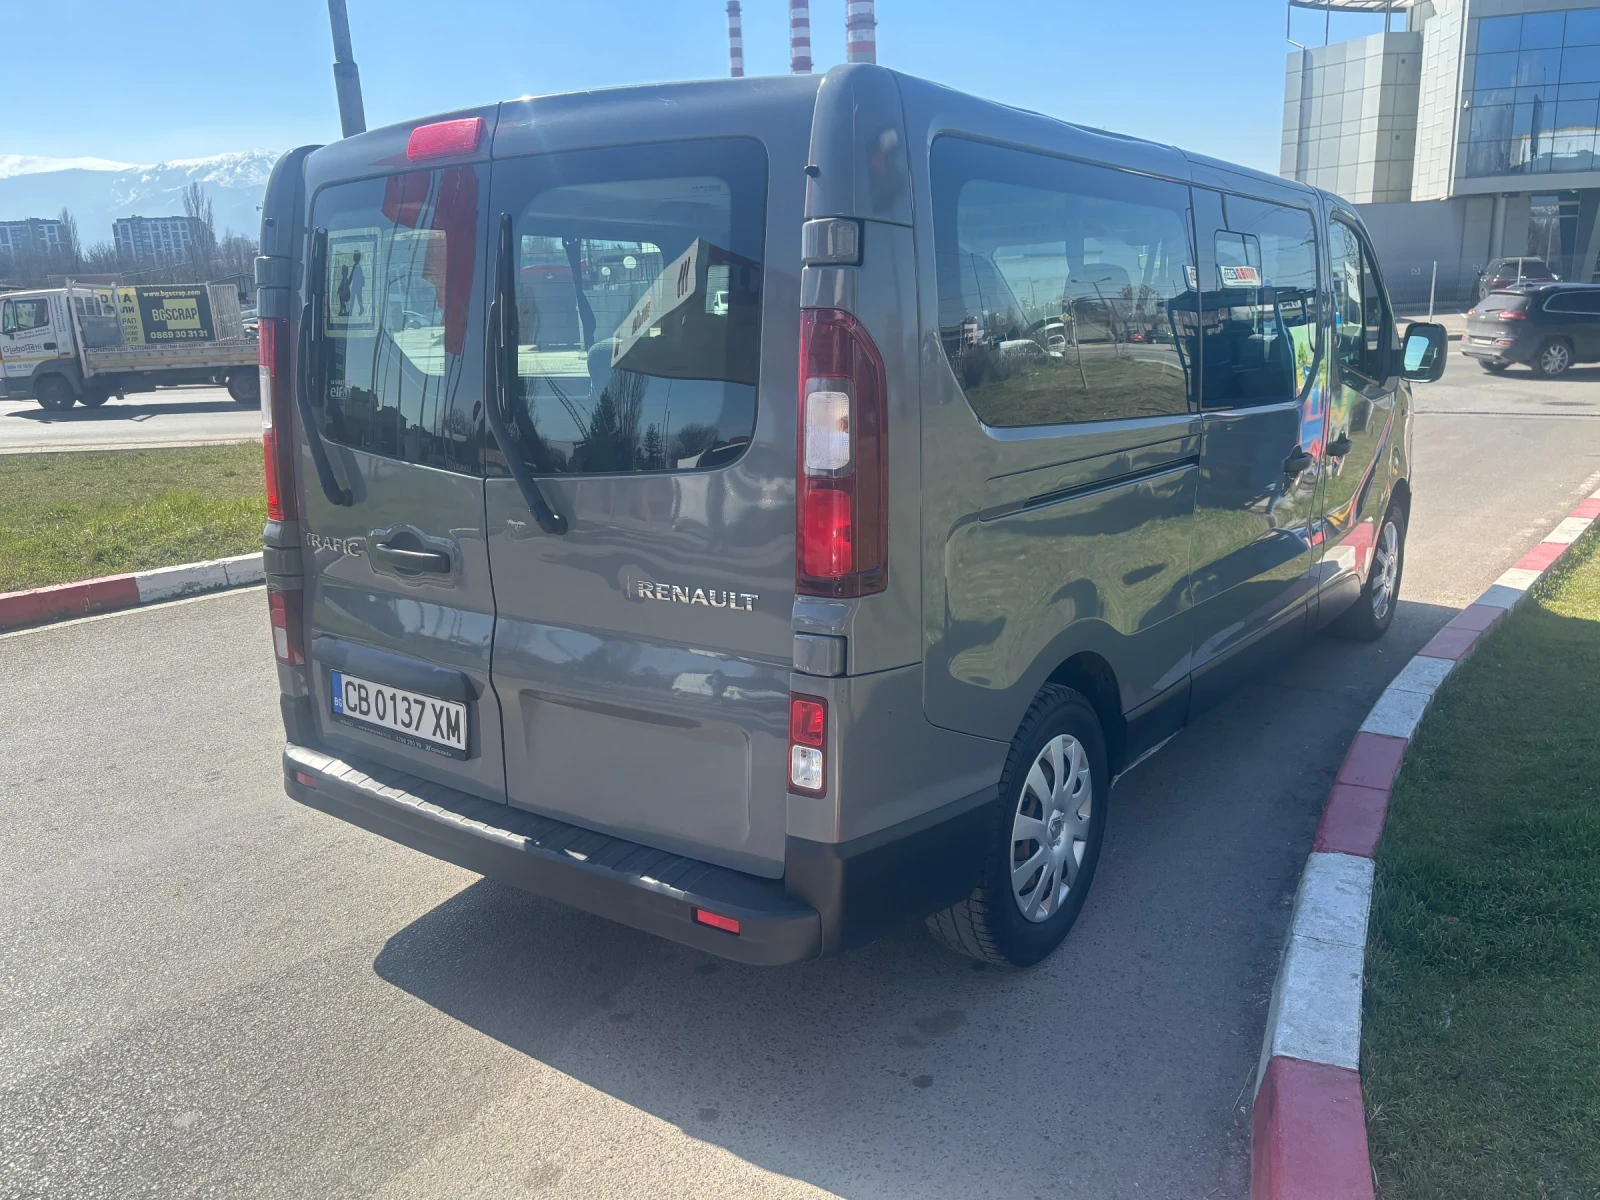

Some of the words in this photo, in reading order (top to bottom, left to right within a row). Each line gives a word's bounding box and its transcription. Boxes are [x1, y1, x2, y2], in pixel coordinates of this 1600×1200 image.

[142, 289, 201, 298] www.bgscrap.com
[151, 307, 198, 322] BGSCRAP
[150, 330, 174, 339] 0889
[174, 330, 187, 338] 30
[187, 329, 198, 338] 31
[198, 329, 208, 337] 31
[305, 532, 362, 557] TRAFIC
[637, 580, 760, 612] RENAULT
[344, 680, 371, 716] CB
[375, 689, 426, 732] 0137
[431, 703, 462, 744] XM
